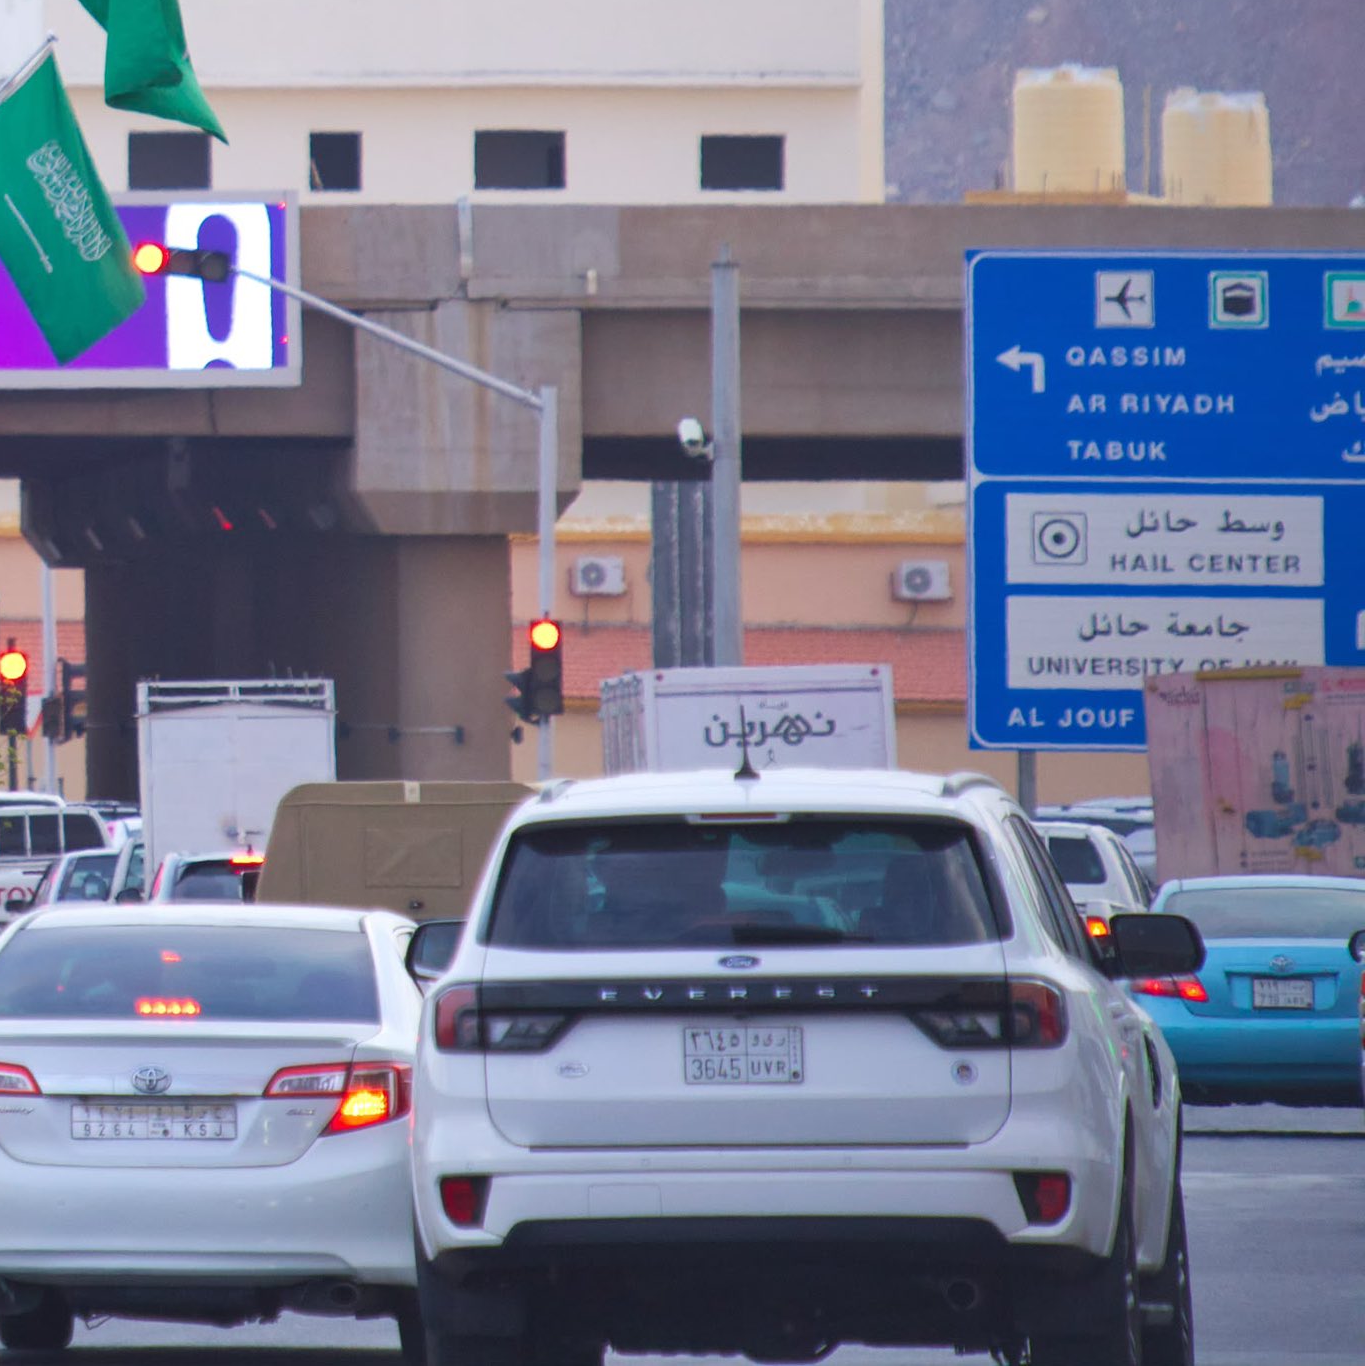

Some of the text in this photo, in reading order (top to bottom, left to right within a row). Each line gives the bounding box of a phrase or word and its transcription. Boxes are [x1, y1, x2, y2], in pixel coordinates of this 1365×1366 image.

[1066, 346, 1186, 367] QASSIM
[1068, 394, 1235, 414] AR RIYADH
[1068, 441, 1167, 461] TABUK
[1126, 510, 1284, 540] وسط حائل
[1110, 554, 1301, 574] HAIL CENTER
[1079, 612, 1249, 643] جامعة حائل
[1027, 656, 1184, 676] UNIVERSITY
[1008, 708, 1134, 727] AL JOUF
[599, 985, 879, 1001] EVEREST
[691, 1057, 787, 1080] 3645 UVR
[83, 1123, 136, 1137] 9264
